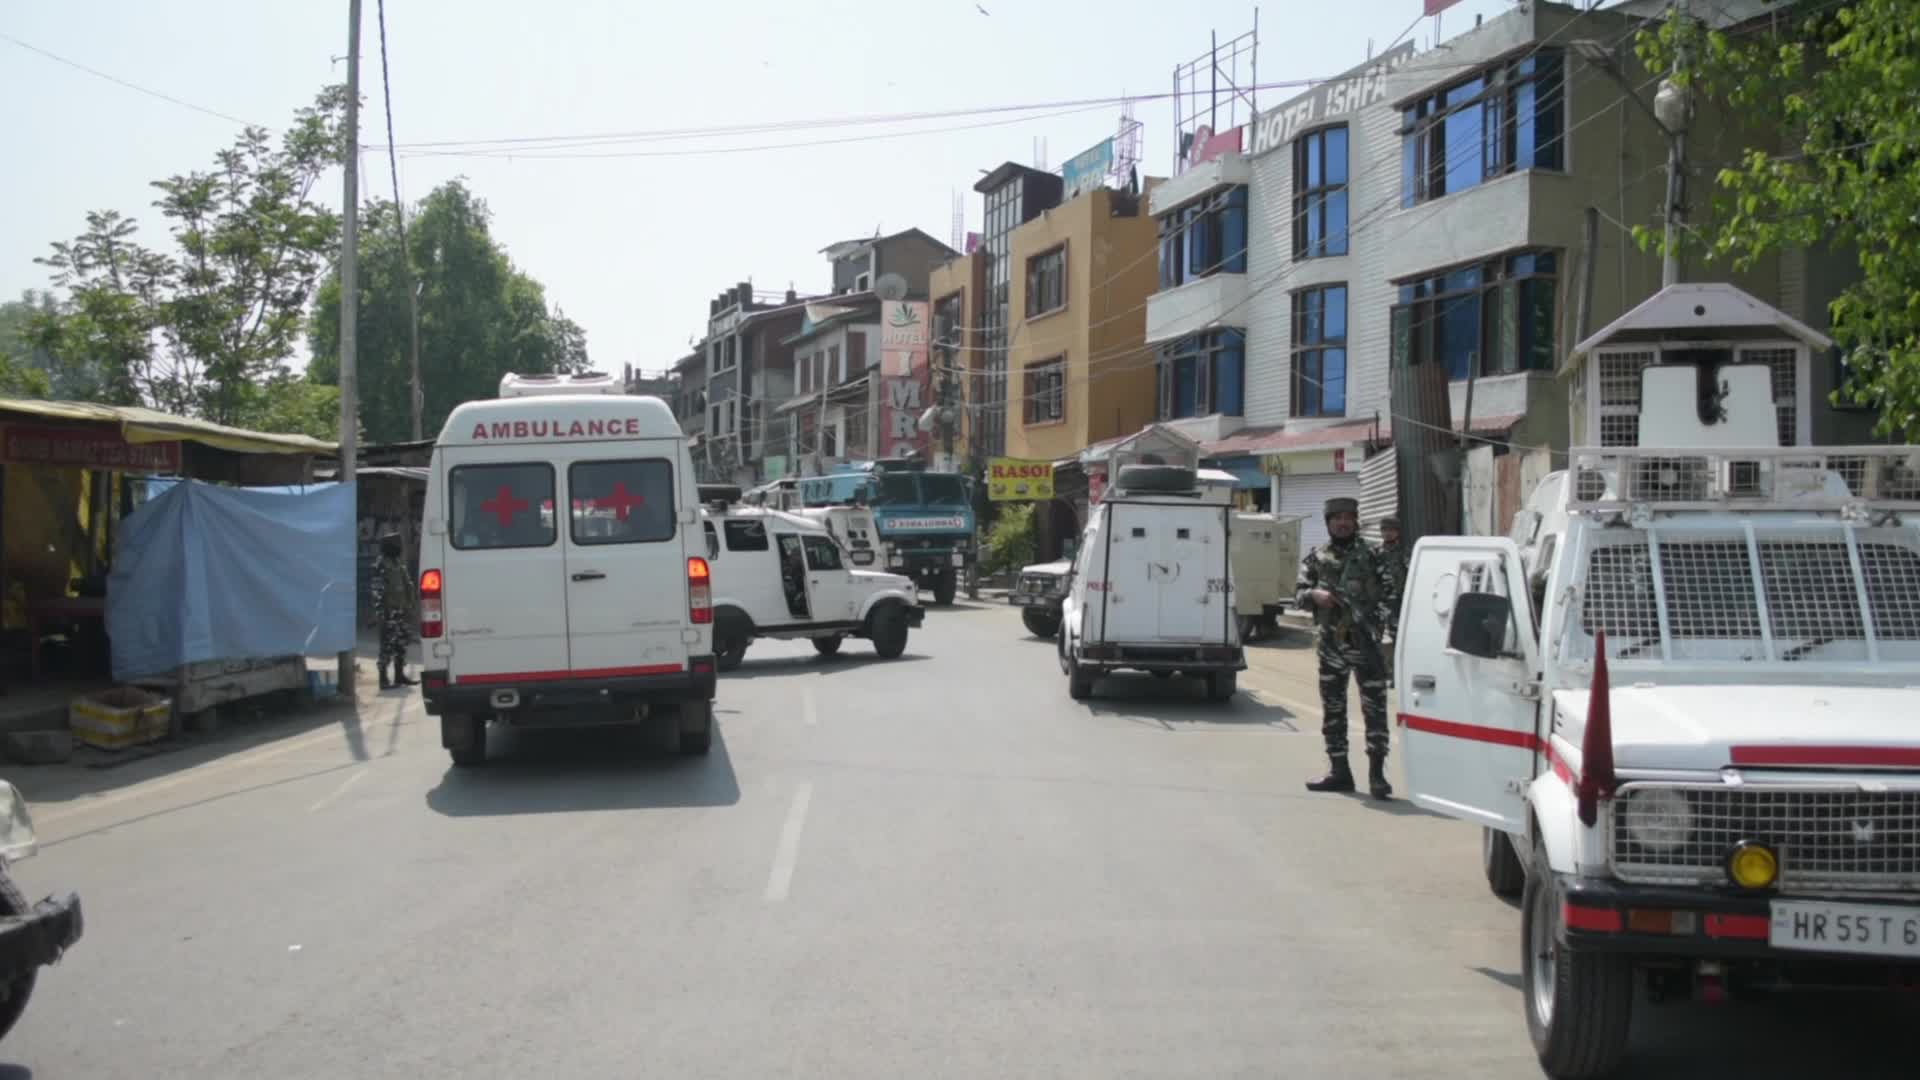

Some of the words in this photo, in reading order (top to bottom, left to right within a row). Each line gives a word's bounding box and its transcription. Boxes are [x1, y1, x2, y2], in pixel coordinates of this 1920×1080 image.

[1256, 97, 1316, 152] HOTEL
[472, 417, 639, 440] AMBULANCE
[992, 463, 1052, 479] RASOI
[1793, 911, 1827, 940] HR
[1836, 914, 1870, 942] 55
[1878, 916, 1892, 944] T
